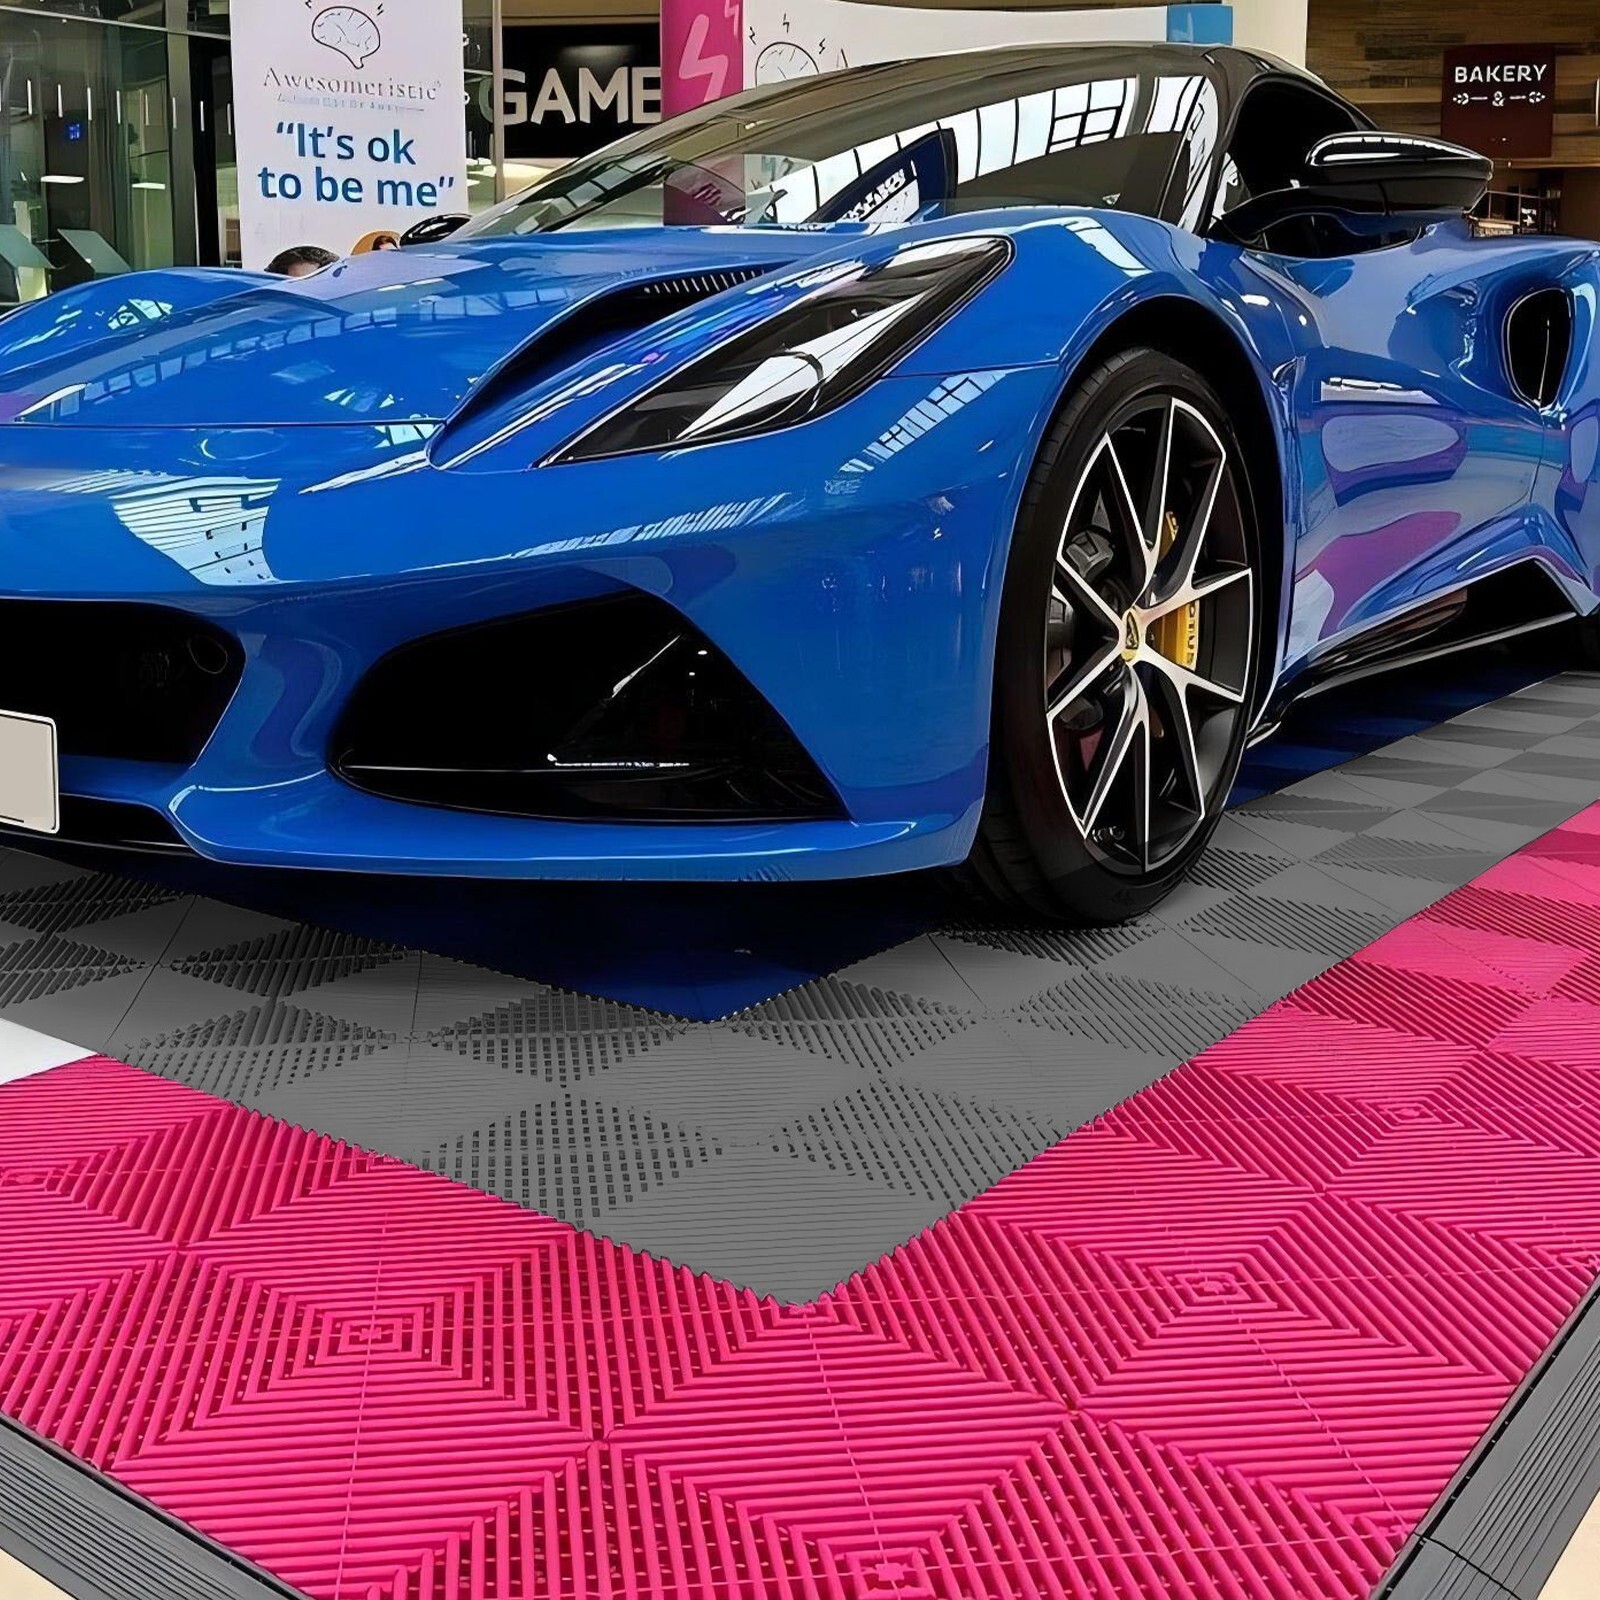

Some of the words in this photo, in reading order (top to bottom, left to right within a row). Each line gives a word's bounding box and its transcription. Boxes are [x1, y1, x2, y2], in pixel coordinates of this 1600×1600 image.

[1455, 64, 1547, 83] BAKERY
[479, 67, 661, 126] GAME
[367, 128, 416, 165] ok
[257, 166, 302, 200] to
[315, 166, 364, 203] be
